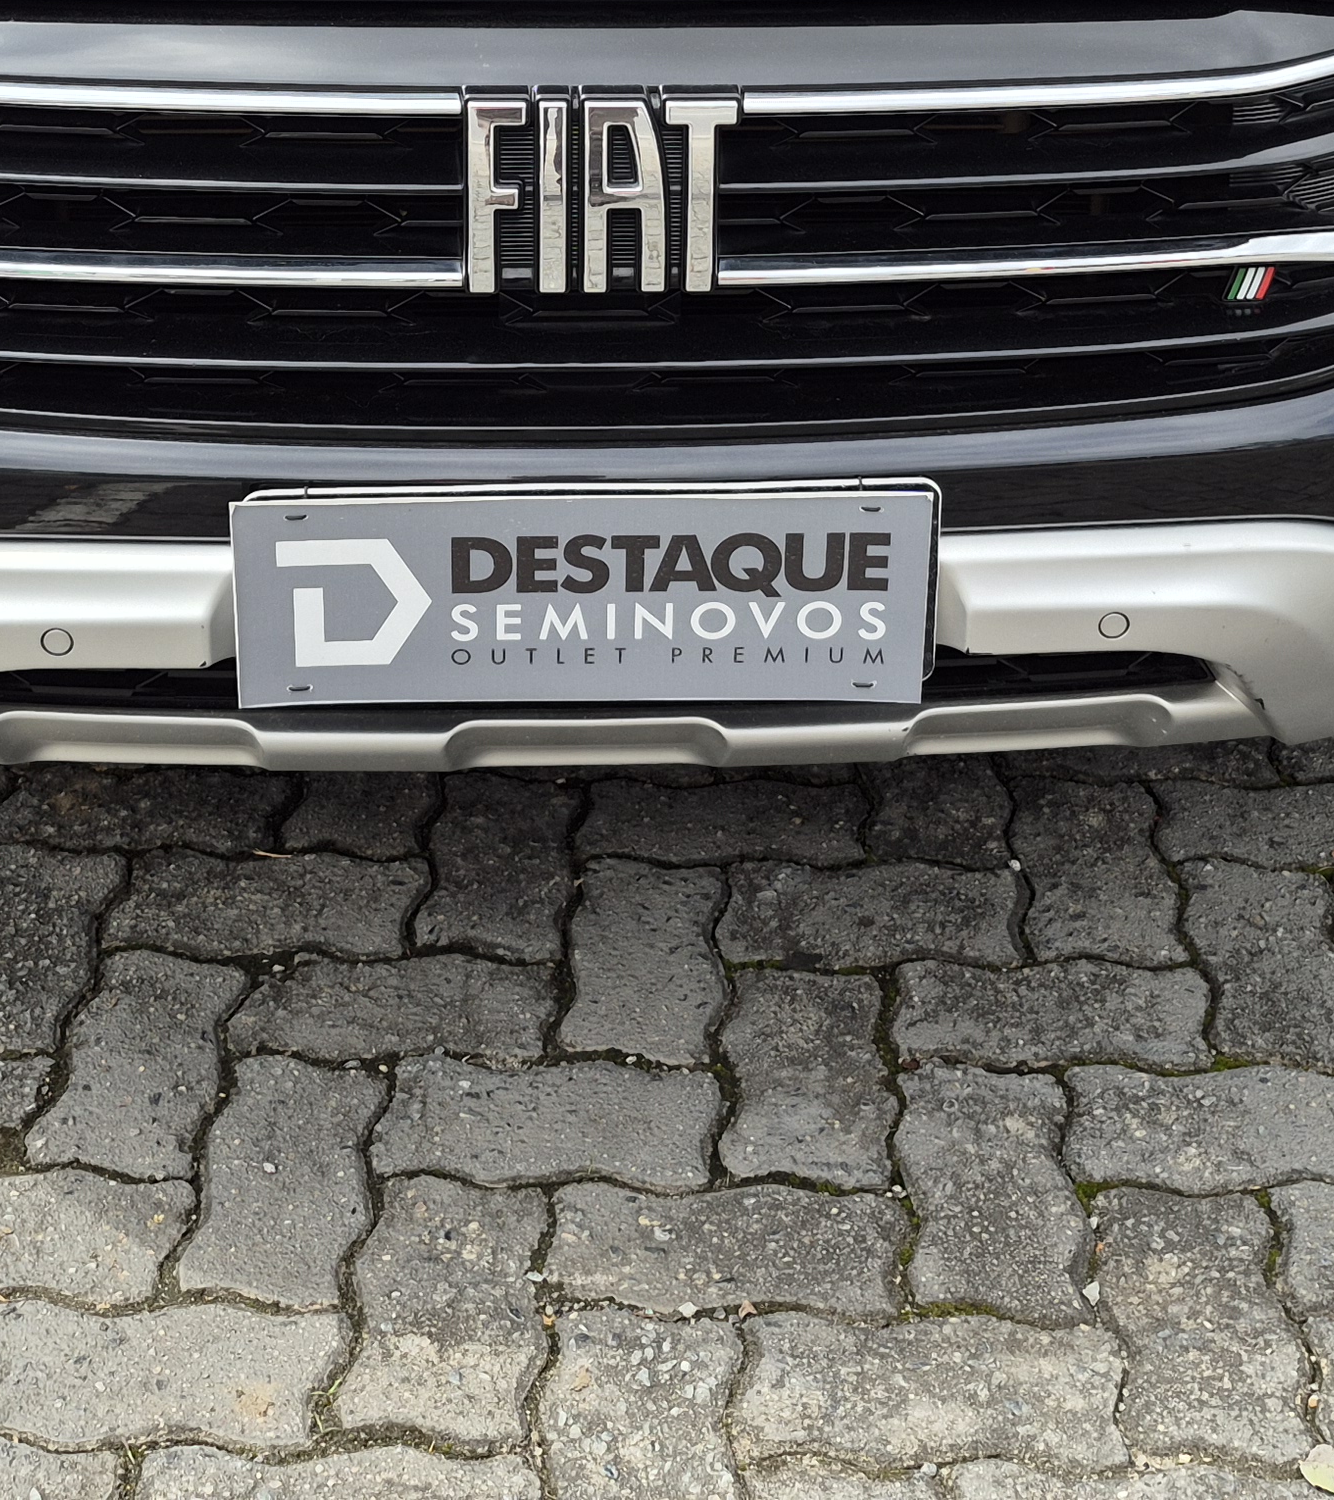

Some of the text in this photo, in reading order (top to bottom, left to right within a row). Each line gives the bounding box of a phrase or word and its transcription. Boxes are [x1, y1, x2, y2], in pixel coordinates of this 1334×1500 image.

[467, 98, 742, 294] FIAT
[450, 532, 892, 598] DESTAQUE
[451, 601, 887, 643] SEMINOVOS
[451, 646, 885, 667] OUTLET PREMIUM
